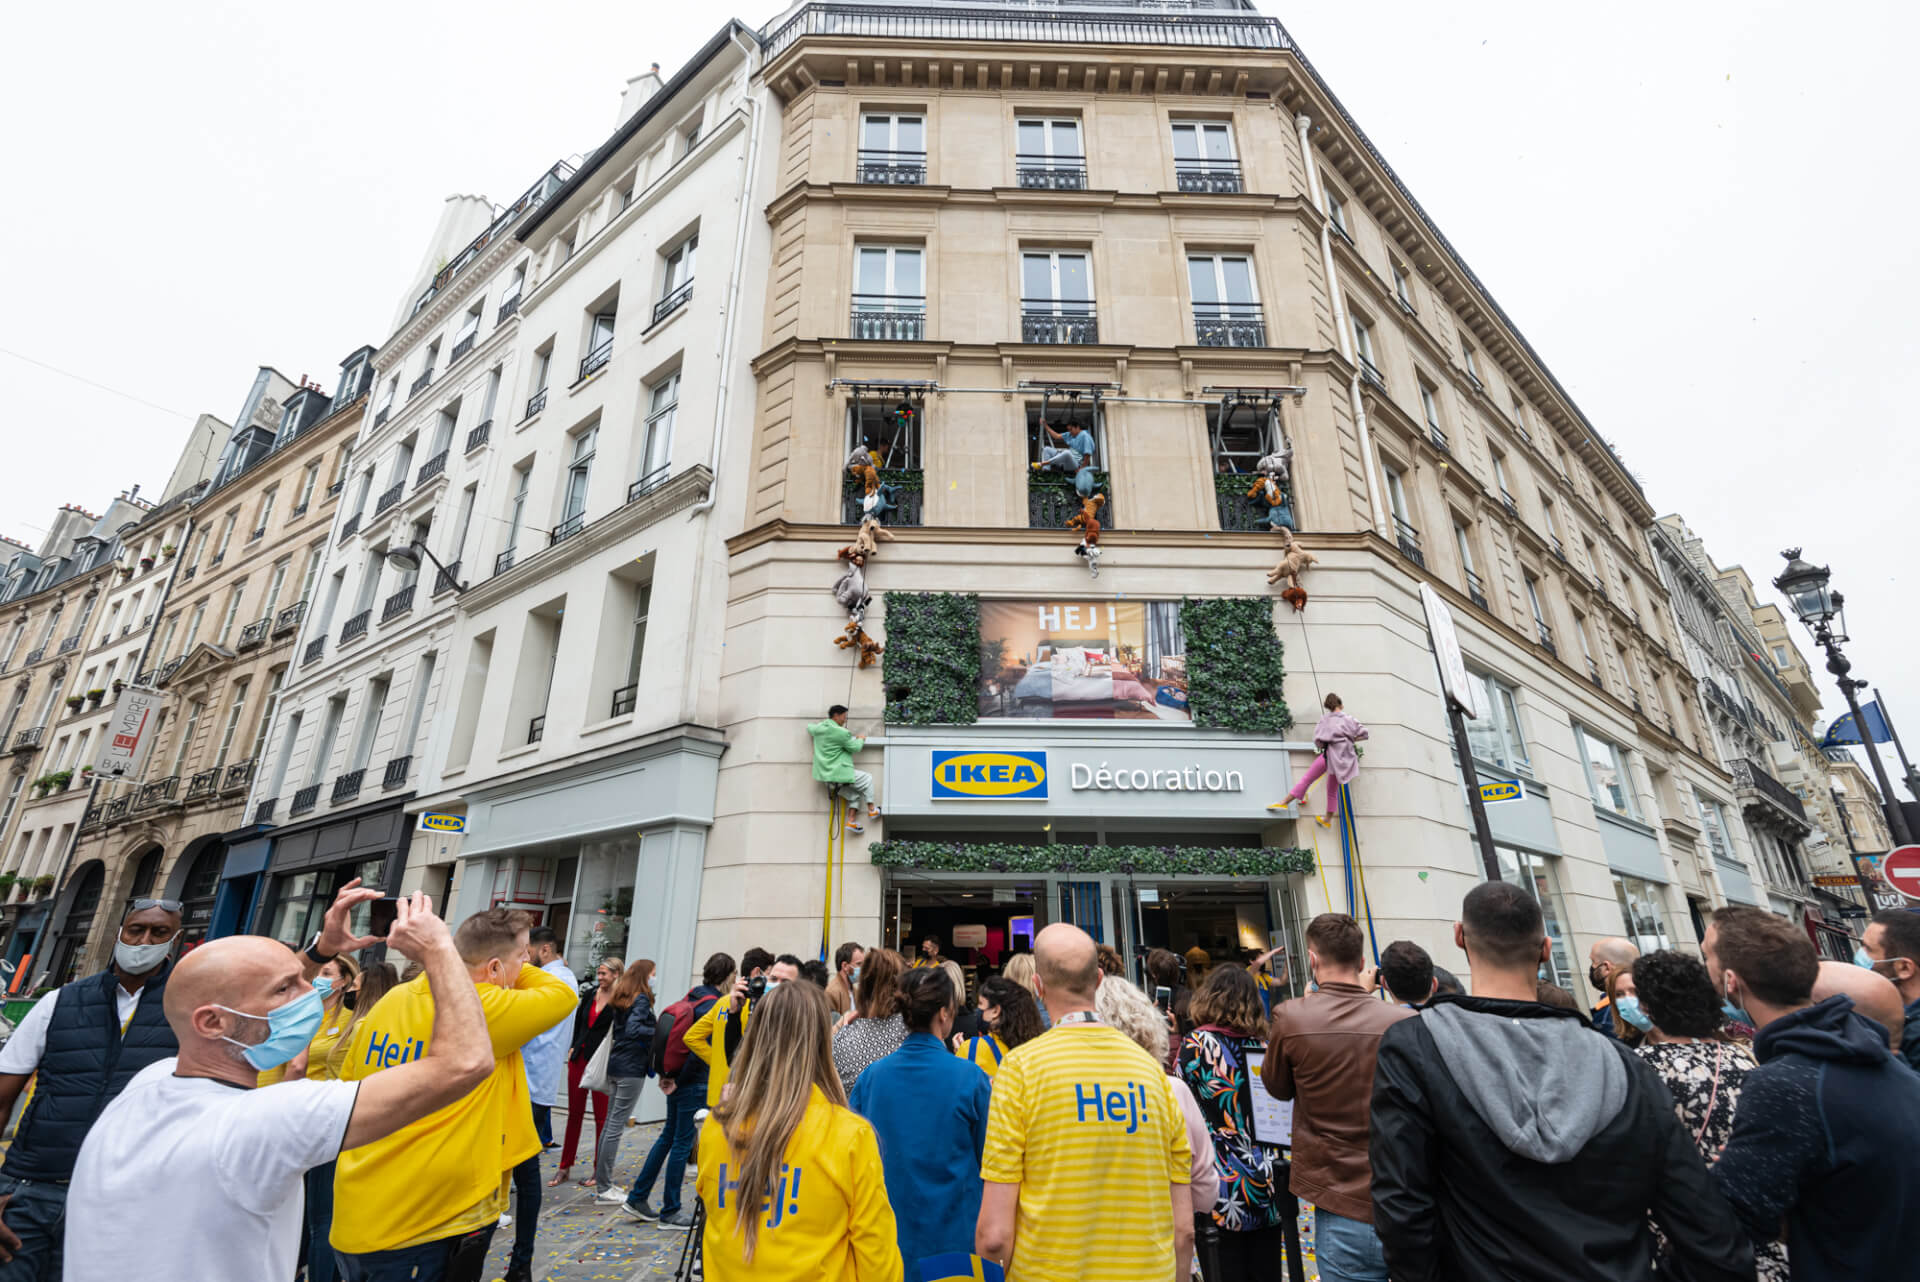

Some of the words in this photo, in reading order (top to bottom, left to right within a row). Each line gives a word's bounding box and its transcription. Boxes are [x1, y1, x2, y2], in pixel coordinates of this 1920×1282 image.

[1038, 606, 1096, 631] HEJ
[103, 759, 131, 772] BAR
[944, 765, 1037, 783] IKEA
[1071, 763, 1244, 791] Décoration
[1482, 786, 1518, 797] KEA
[427, 817, 461, 828] IKEA
[1873, 893, 1908, 910] LUCA
[1075, 1081, 1148, 1134] Hej!
